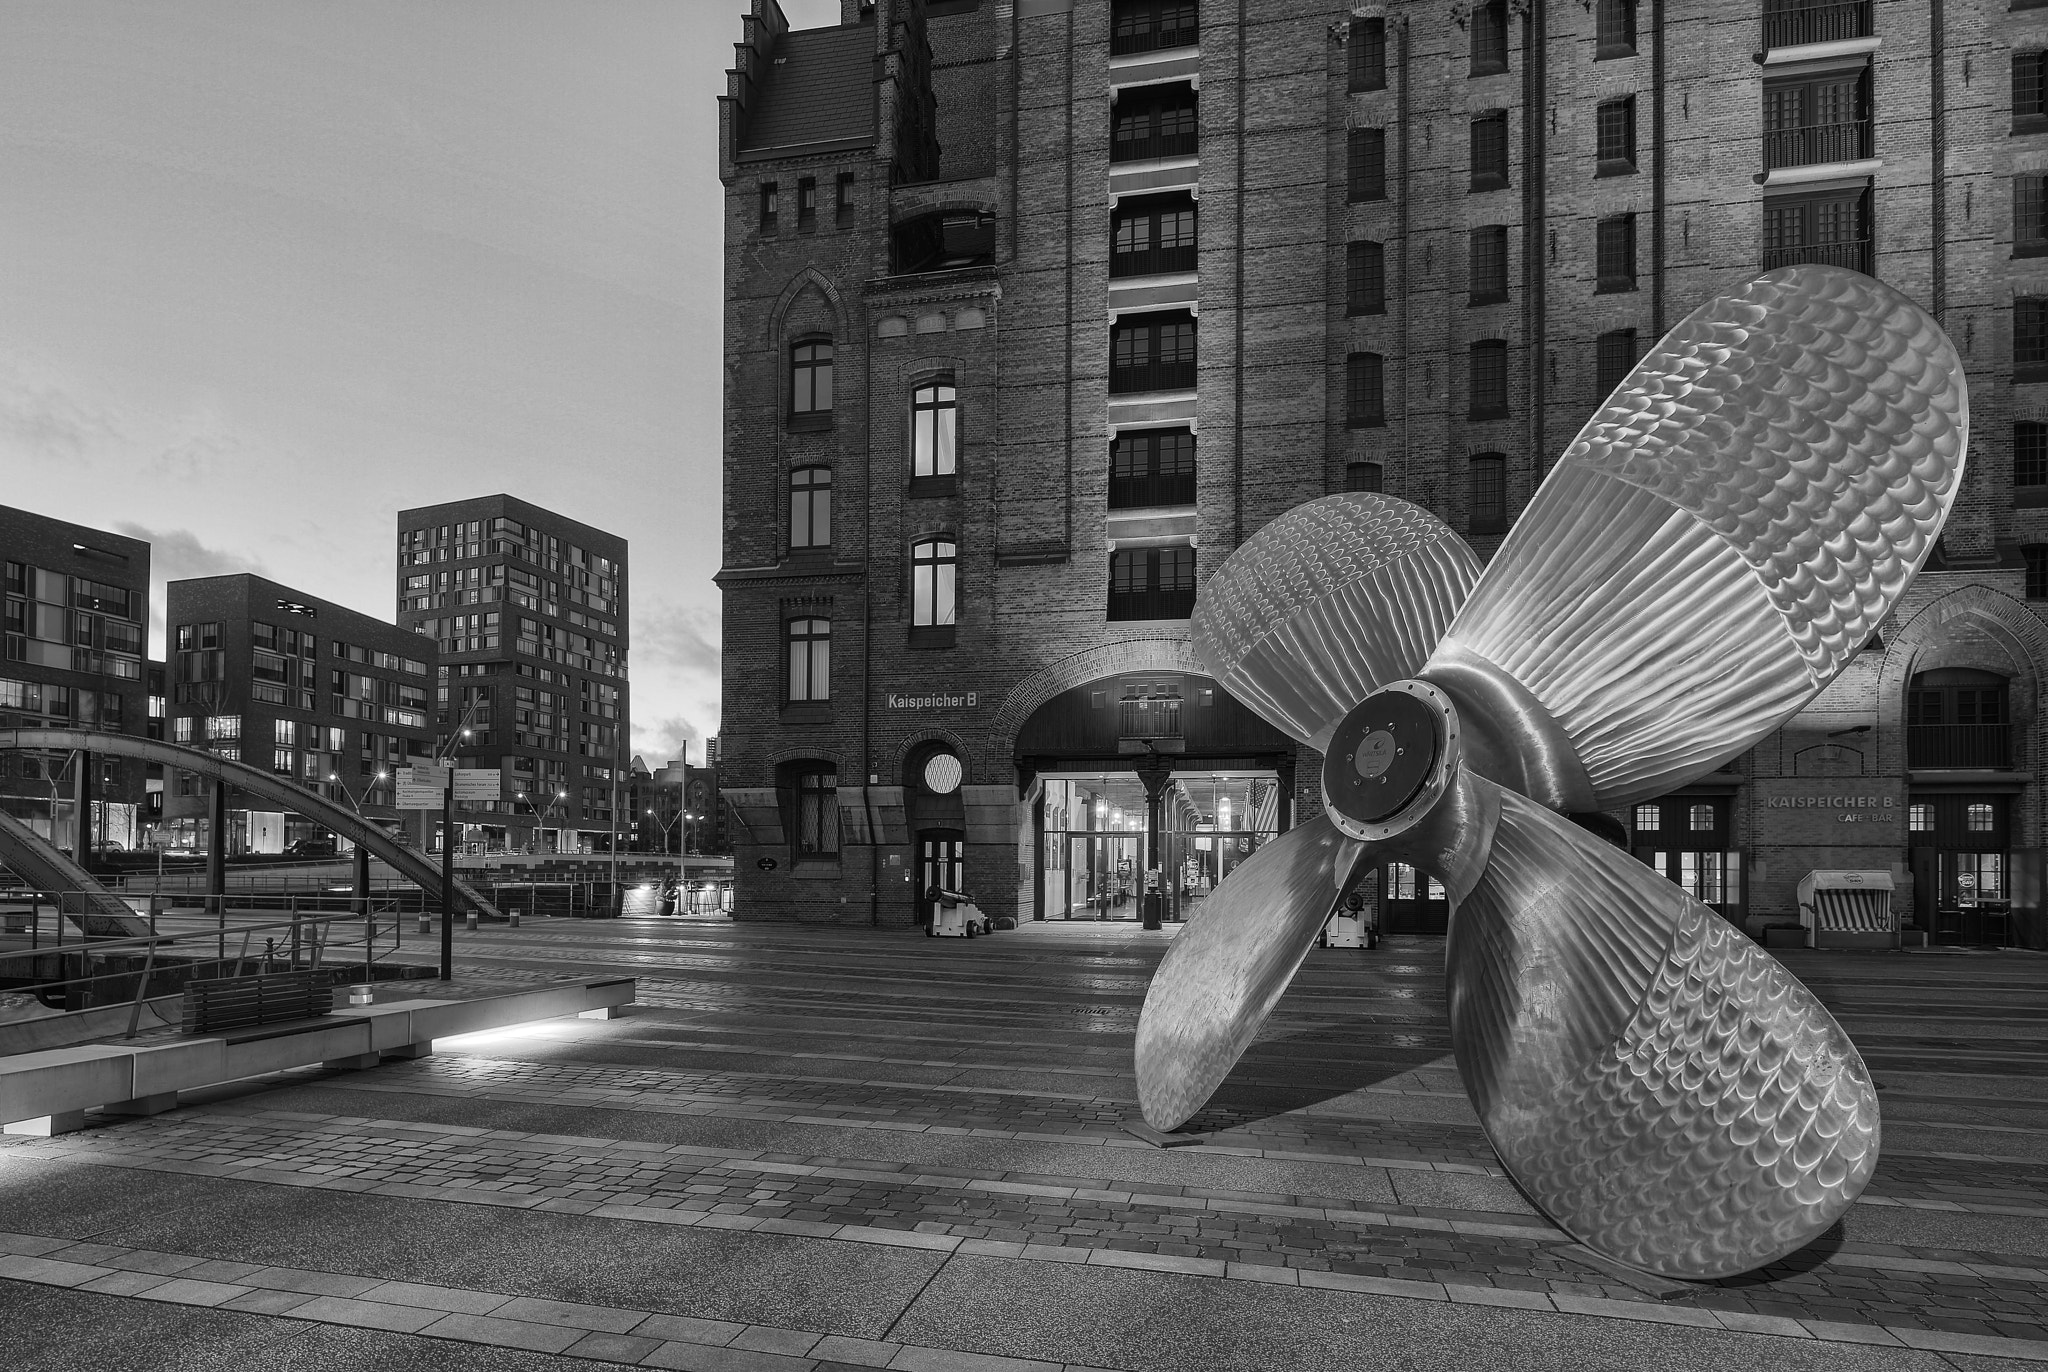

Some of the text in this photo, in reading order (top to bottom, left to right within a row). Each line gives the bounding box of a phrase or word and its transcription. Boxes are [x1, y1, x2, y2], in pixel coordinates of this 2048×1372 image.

[889, 692, 977, 709] Kaispeicher B
[1767, 796, 1893, 808] KAISPEICHER B
[1872, 814, 1893, 822] BAR
